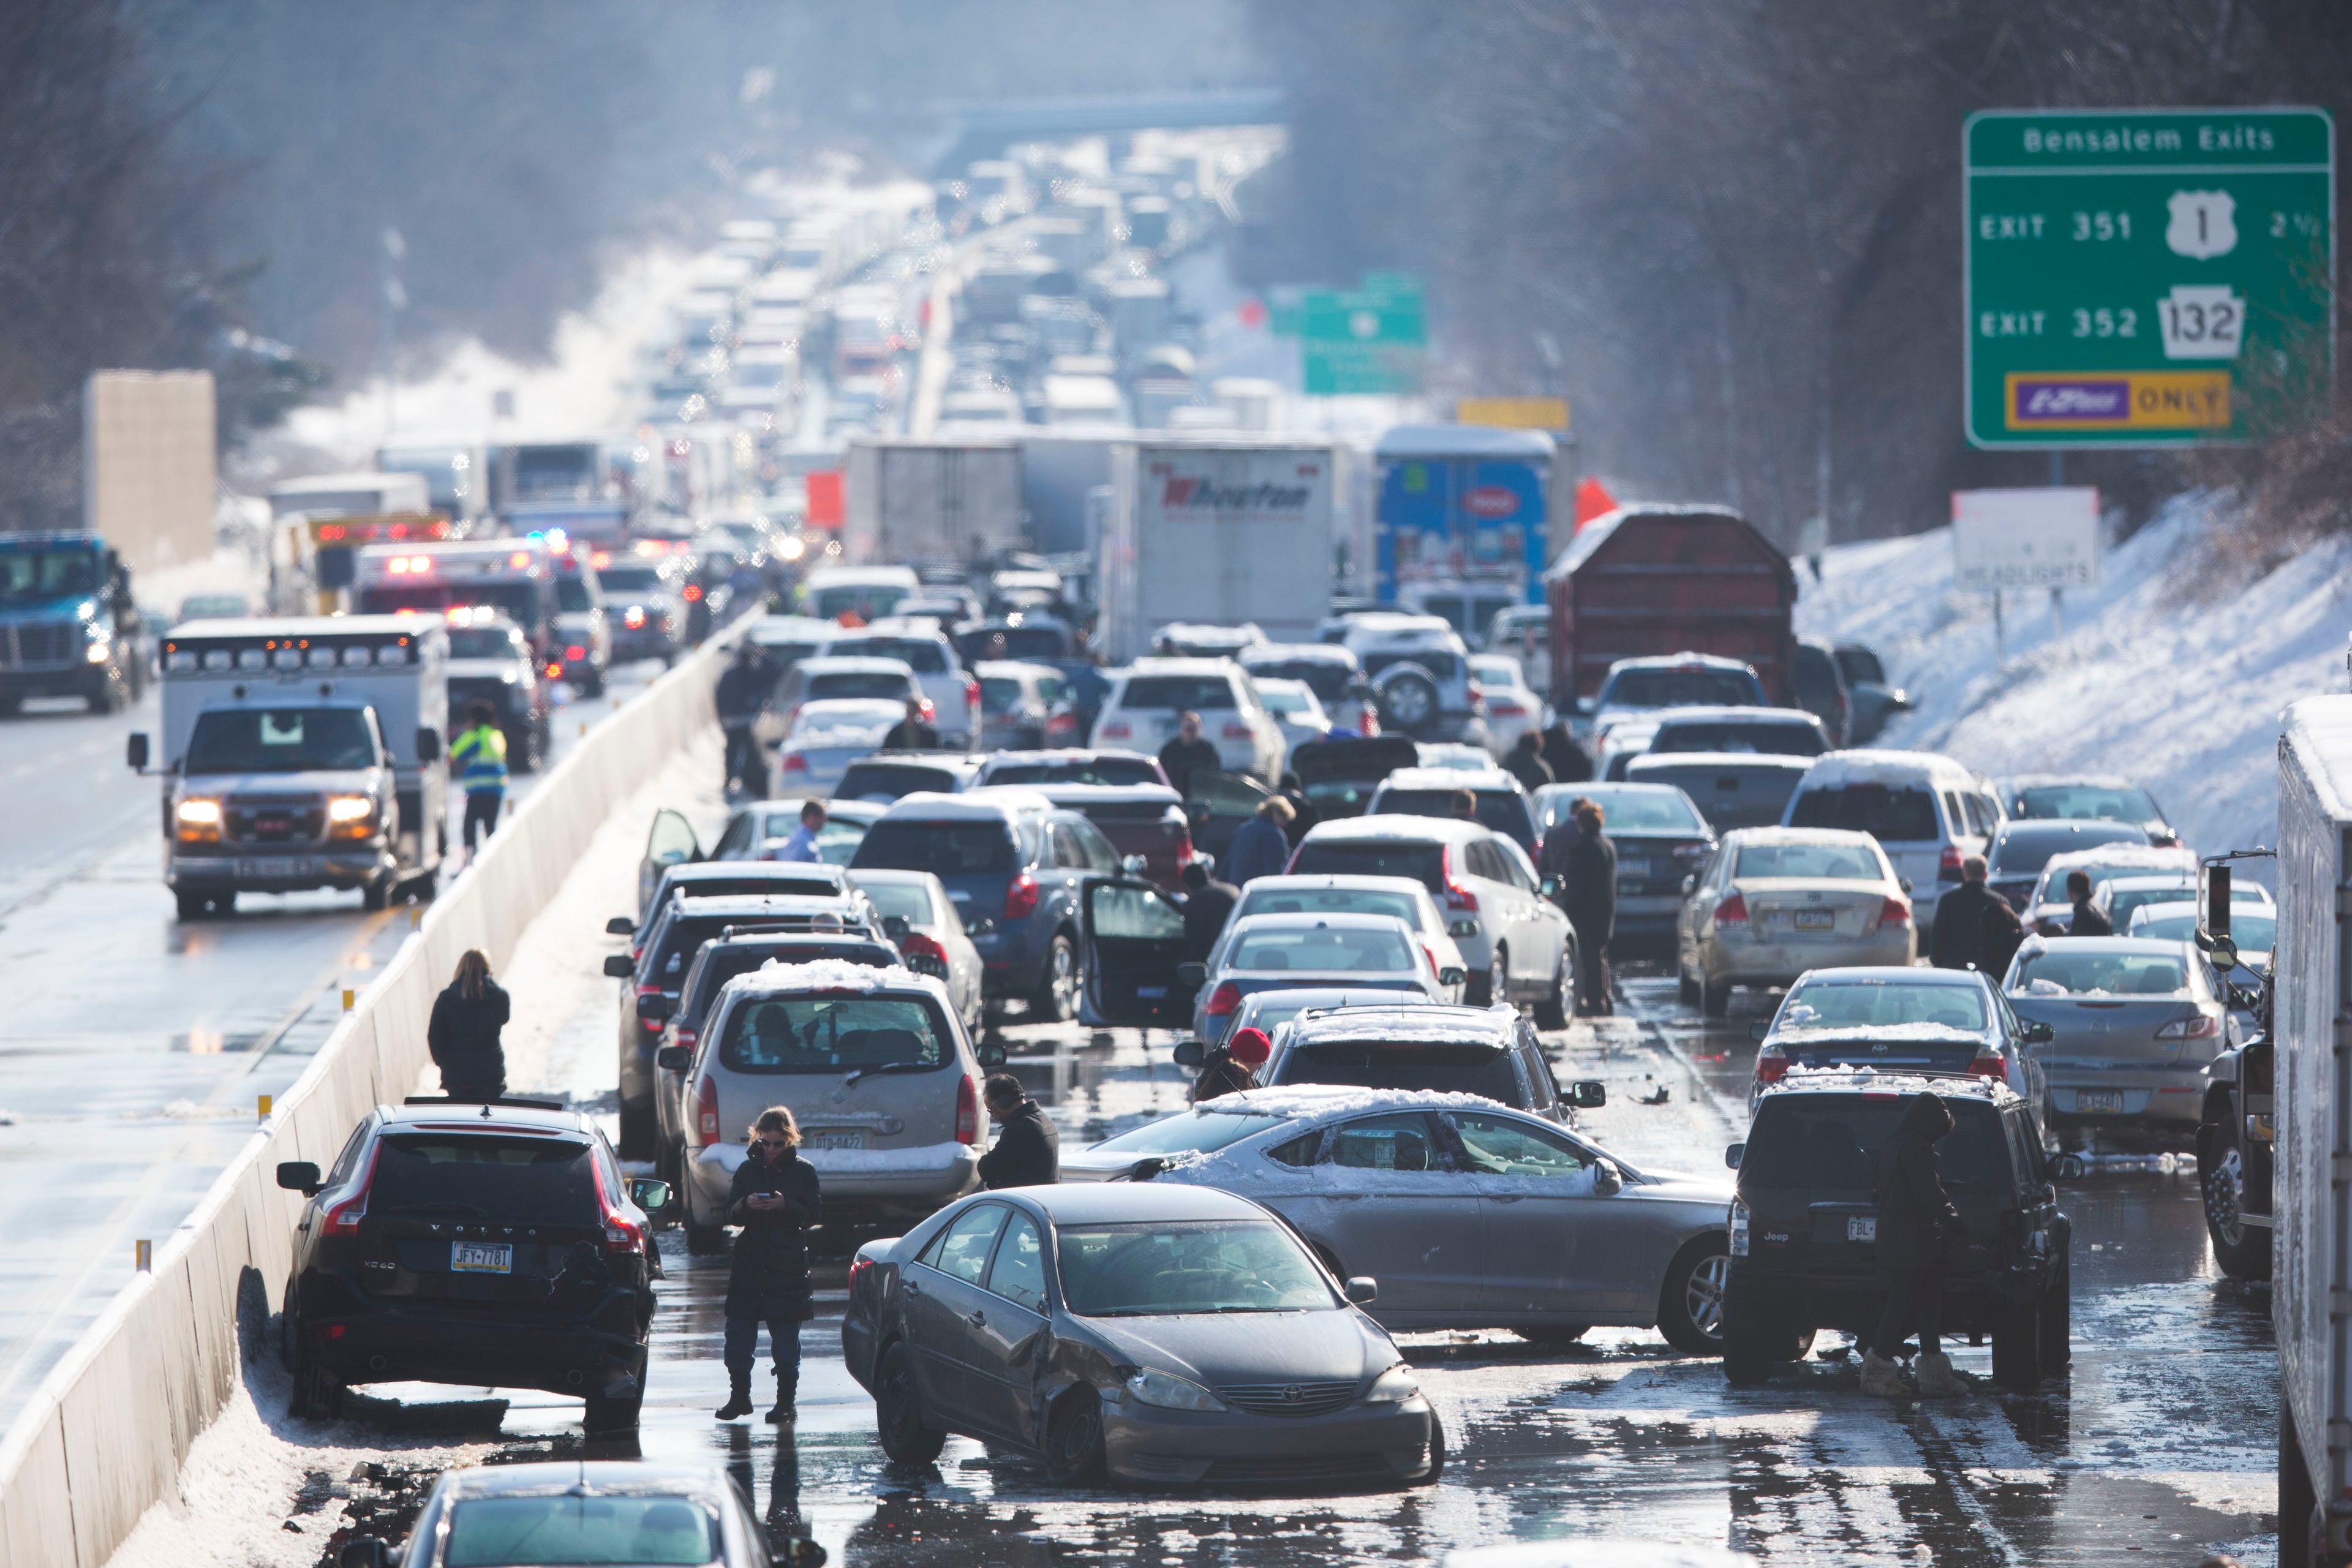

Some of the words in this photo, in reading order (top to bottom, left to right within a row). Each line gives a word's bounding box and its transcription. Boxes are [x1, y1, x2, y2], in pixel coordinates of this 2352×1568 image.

[2024, 126, 2182, 153] Bensalem
[2199, 124, 2274, 151] Exits
[1980, 213, 2045, 240] EXIT
[2072, 211, 2131, 241] 351
[2198, 206, 2207, 244] 1
[1980, 311, 2046, 337] EXIT
[2073, 308, 2138, 338] 352
[2170, 302, 2236, 342] 132
[2138, 388, 2219, 412] ONLY
[431, 1224, 537, 1235] VOLVO
[1764, 1232, 1789, 1242] Jeep
[363, 1261, 395, 1269] XC60
